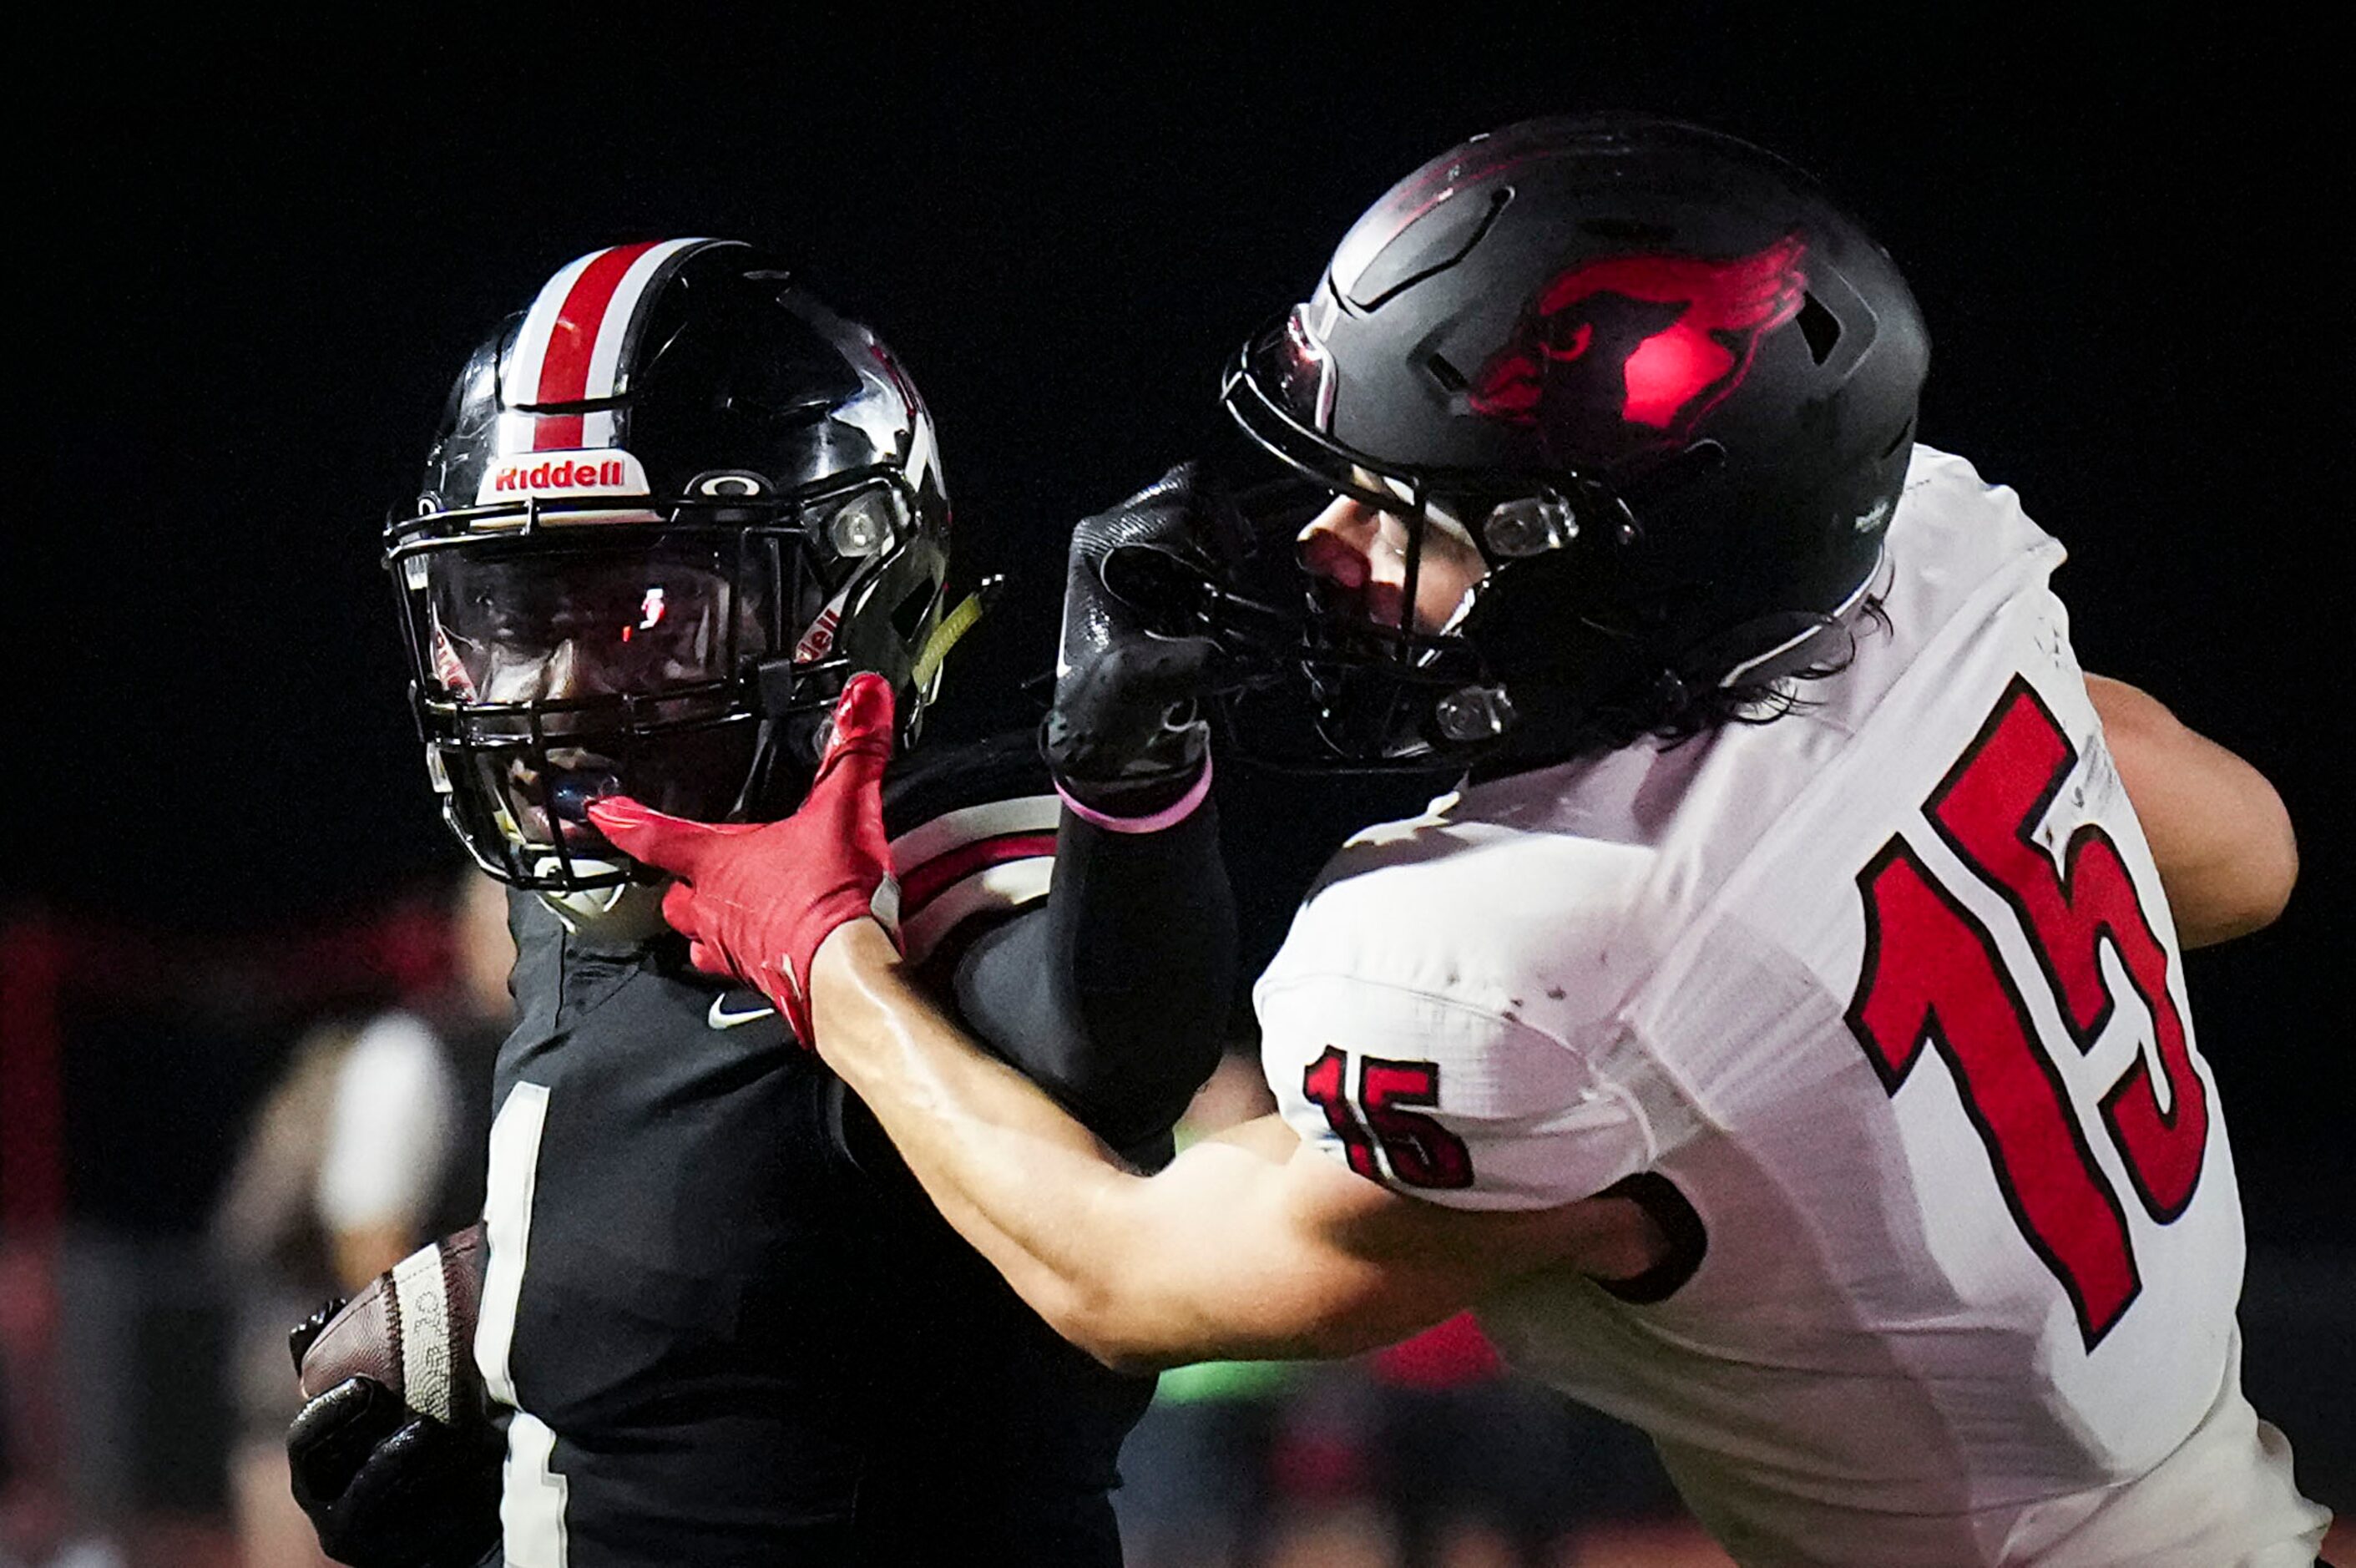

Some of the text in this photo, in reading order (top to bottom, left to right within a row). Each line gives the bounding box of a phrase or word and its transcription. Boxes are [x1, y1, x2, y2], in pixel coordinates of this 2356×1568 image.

[495, 460, 624, 491] Riddell
[1843, 671, 2208, 1354] 15
[1302, 1044, 1474, 1196] 15
